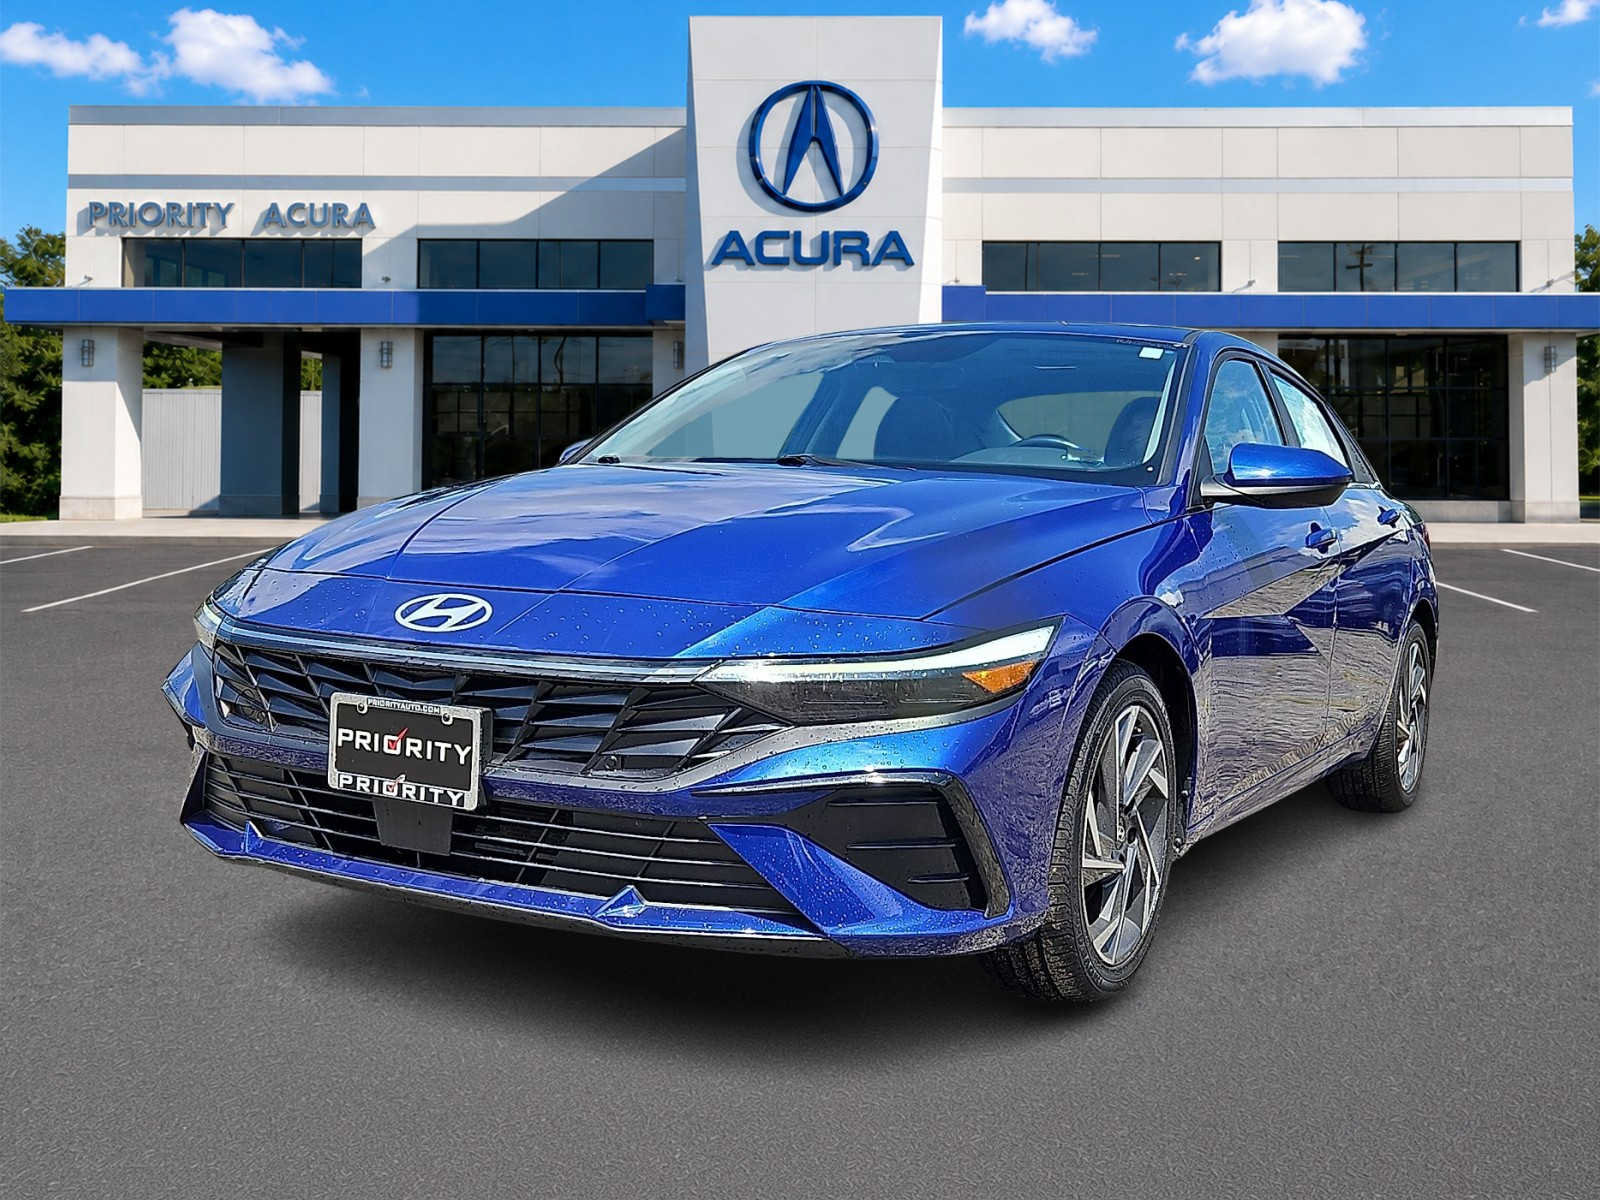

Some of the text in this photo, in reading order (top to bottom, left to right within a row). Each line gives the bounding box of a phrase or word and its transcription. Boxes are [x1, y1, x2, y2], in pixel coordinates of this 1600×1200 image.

[89, 202, 376, 228] PRIORITY ACURA
[711, 230, 915, 267] ACURA
[367, 698, 440, 714] PRIORITYAUTO.COM
[337, 728, 471, 764] PRIORITY
[339, 774, 464, 806] PRIORITY
